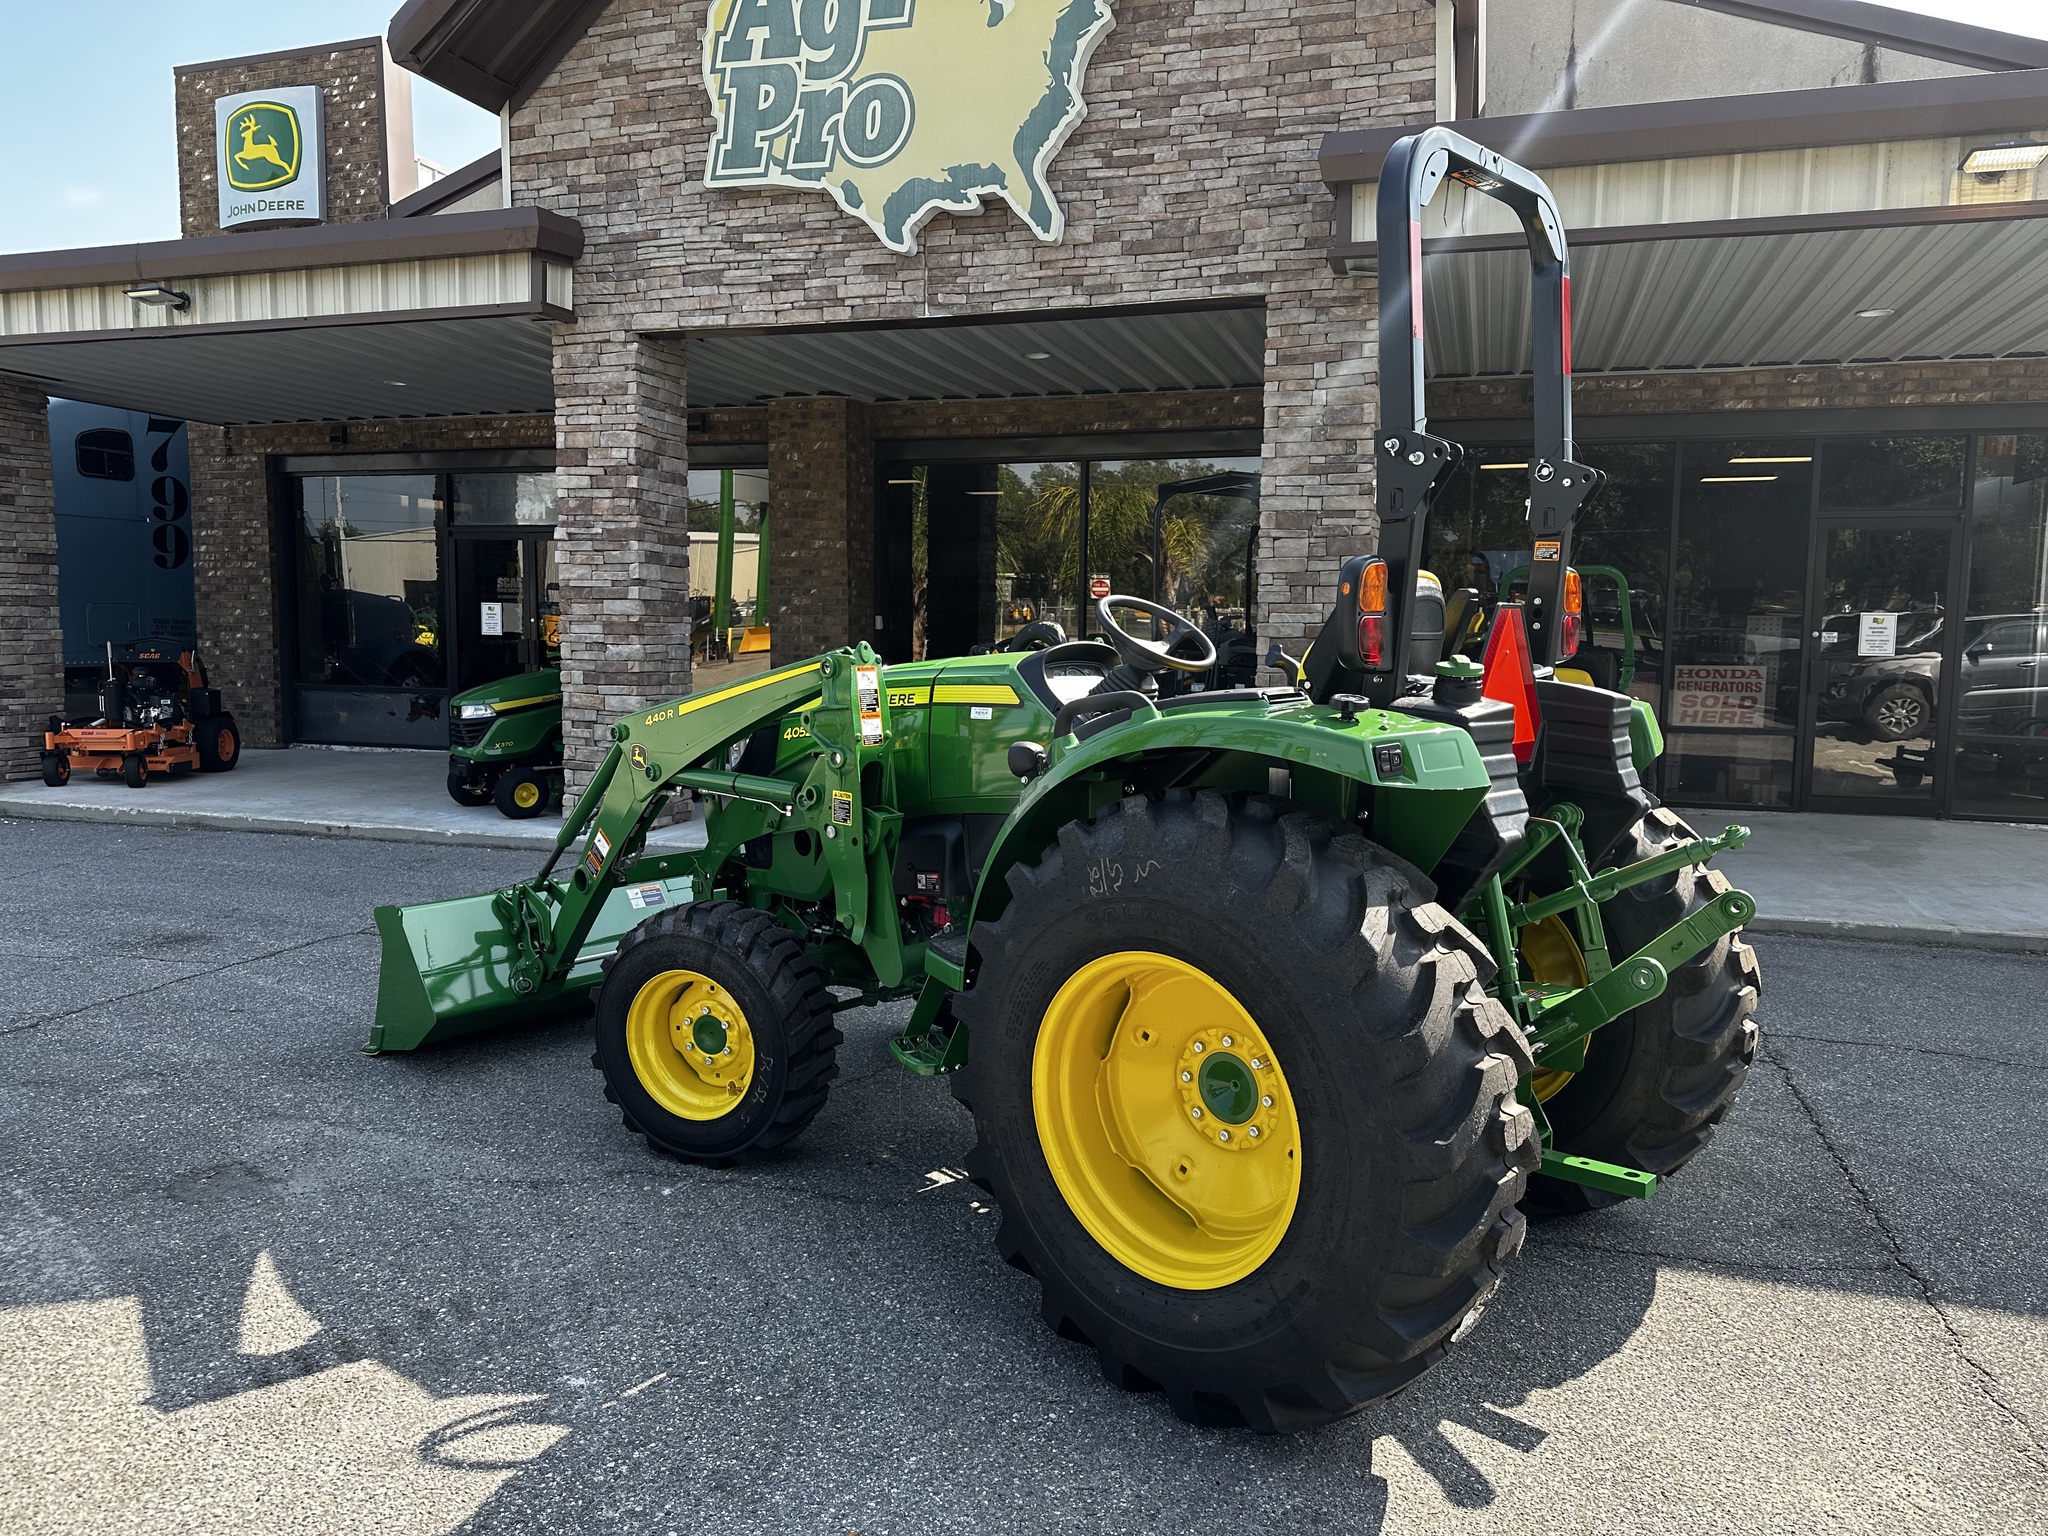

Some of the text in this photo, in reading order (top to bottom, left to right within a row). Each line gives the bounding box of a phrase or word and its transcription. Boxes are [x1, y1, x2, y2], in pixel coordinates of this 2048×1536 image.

[714, 64, 913, 180] Pro
[227, 199, 305, 218] JOHN DEERE
[146, 414, 190, 570] 799
[1676, 669, 1764, 679] HONDA
[1676, 680, 1763, 693] GENERATORS
[886, 693, 916, 706] ERE
[1680, 695, 1759, 709] SOLD
[1680, 709, 1756, 724] HERE
[494, 741, 514, 749] X370
